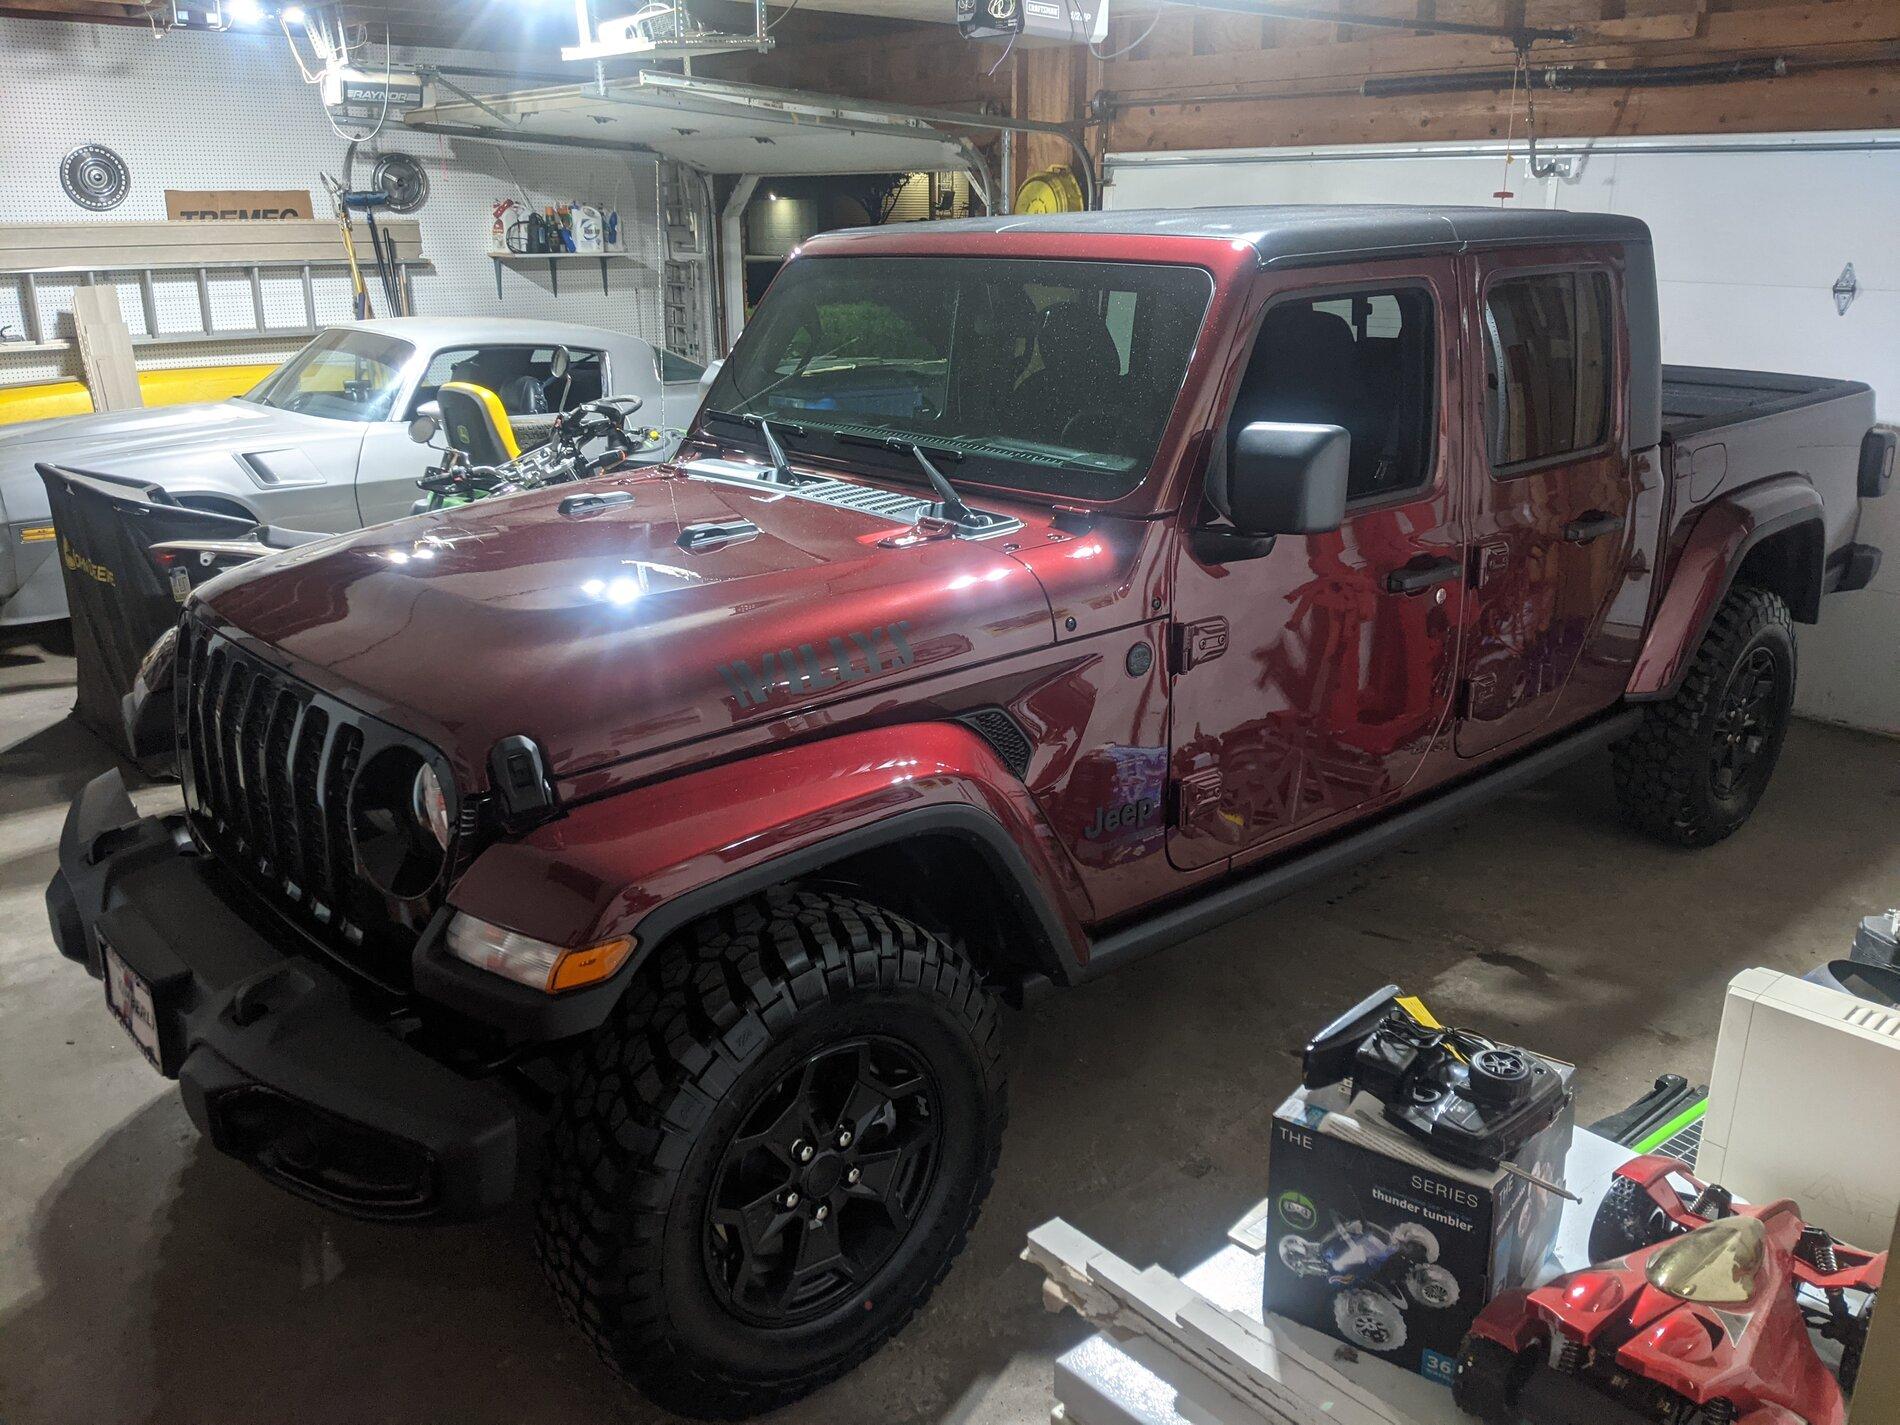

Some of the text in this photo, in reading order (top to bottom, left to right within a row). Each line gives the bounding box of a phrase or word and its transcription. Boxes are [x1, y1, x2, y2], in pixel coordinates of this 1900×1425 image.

[1028, 3, 1058, 16] CRAFTSMAN
[352, 90, 408, 101] RAYNOR
[715, 620, 914, 709] WILLYS
[1083, 797, 1154, 840] Jeep
[1280, 1126, 1313, 1150] THE
[1411, 1174, 1479, 1209] SERIES
[1371, 1187, 1421, 1214] thunder
[1422, 1206, 1474, 1233] tumbler
